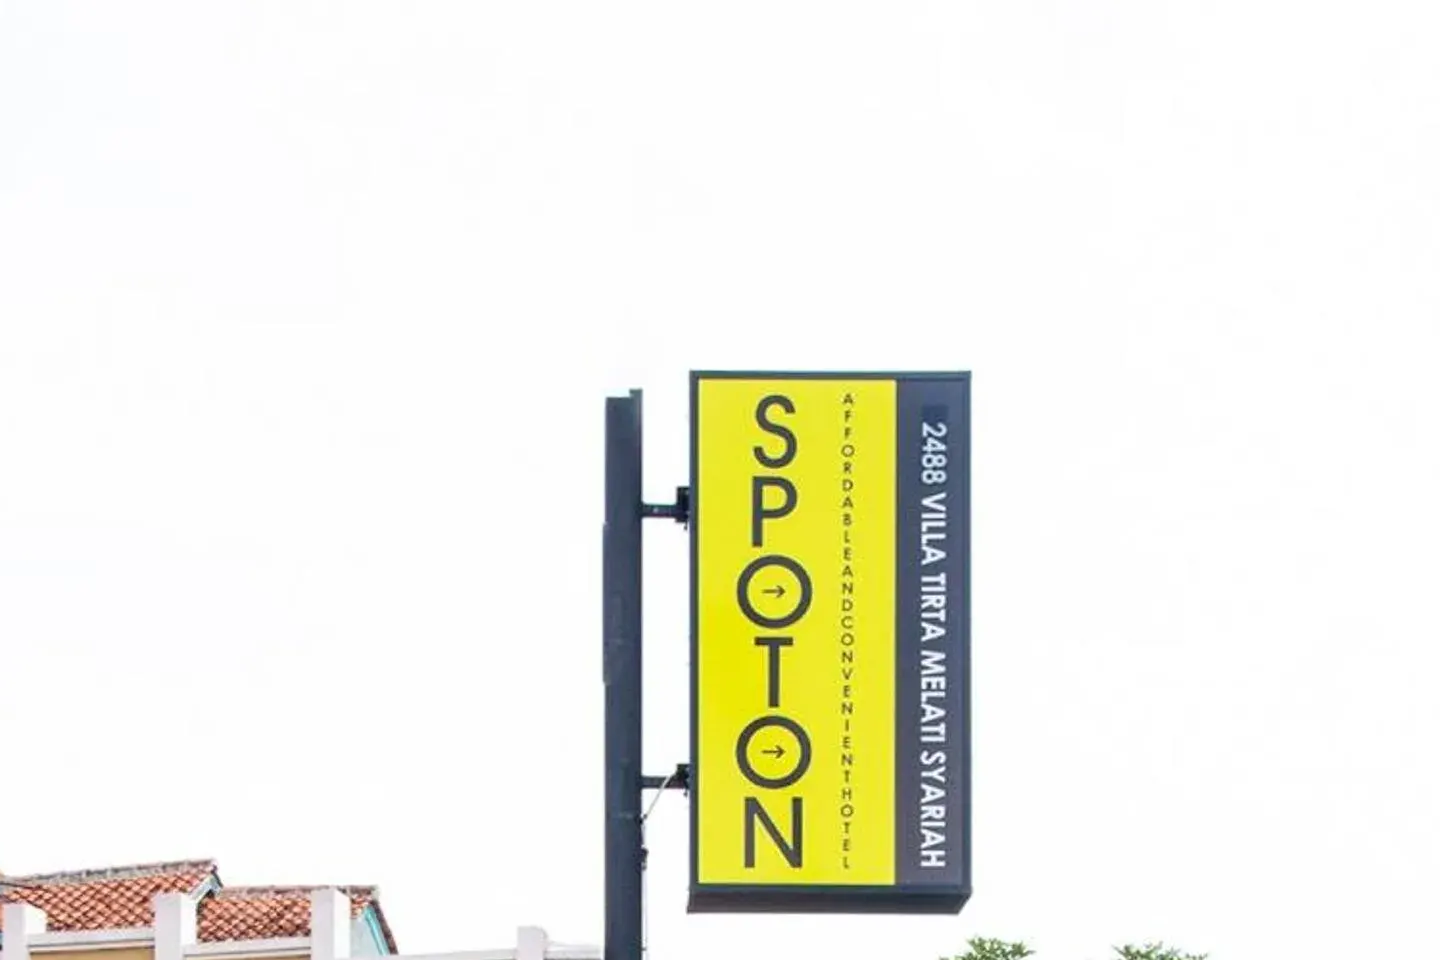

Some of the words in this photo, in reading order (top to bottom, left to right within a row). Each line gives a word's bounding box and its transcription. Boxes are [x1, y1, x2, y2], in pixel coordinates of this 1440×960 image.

[921, 422, 948, 485] 2488
[921, 491, 948, 566] VILLA
[920, 571, 947, 643] TIRTA
[919, 649, 947, 743] MELATI
[919, 749, 947, 868] SYARIAH
